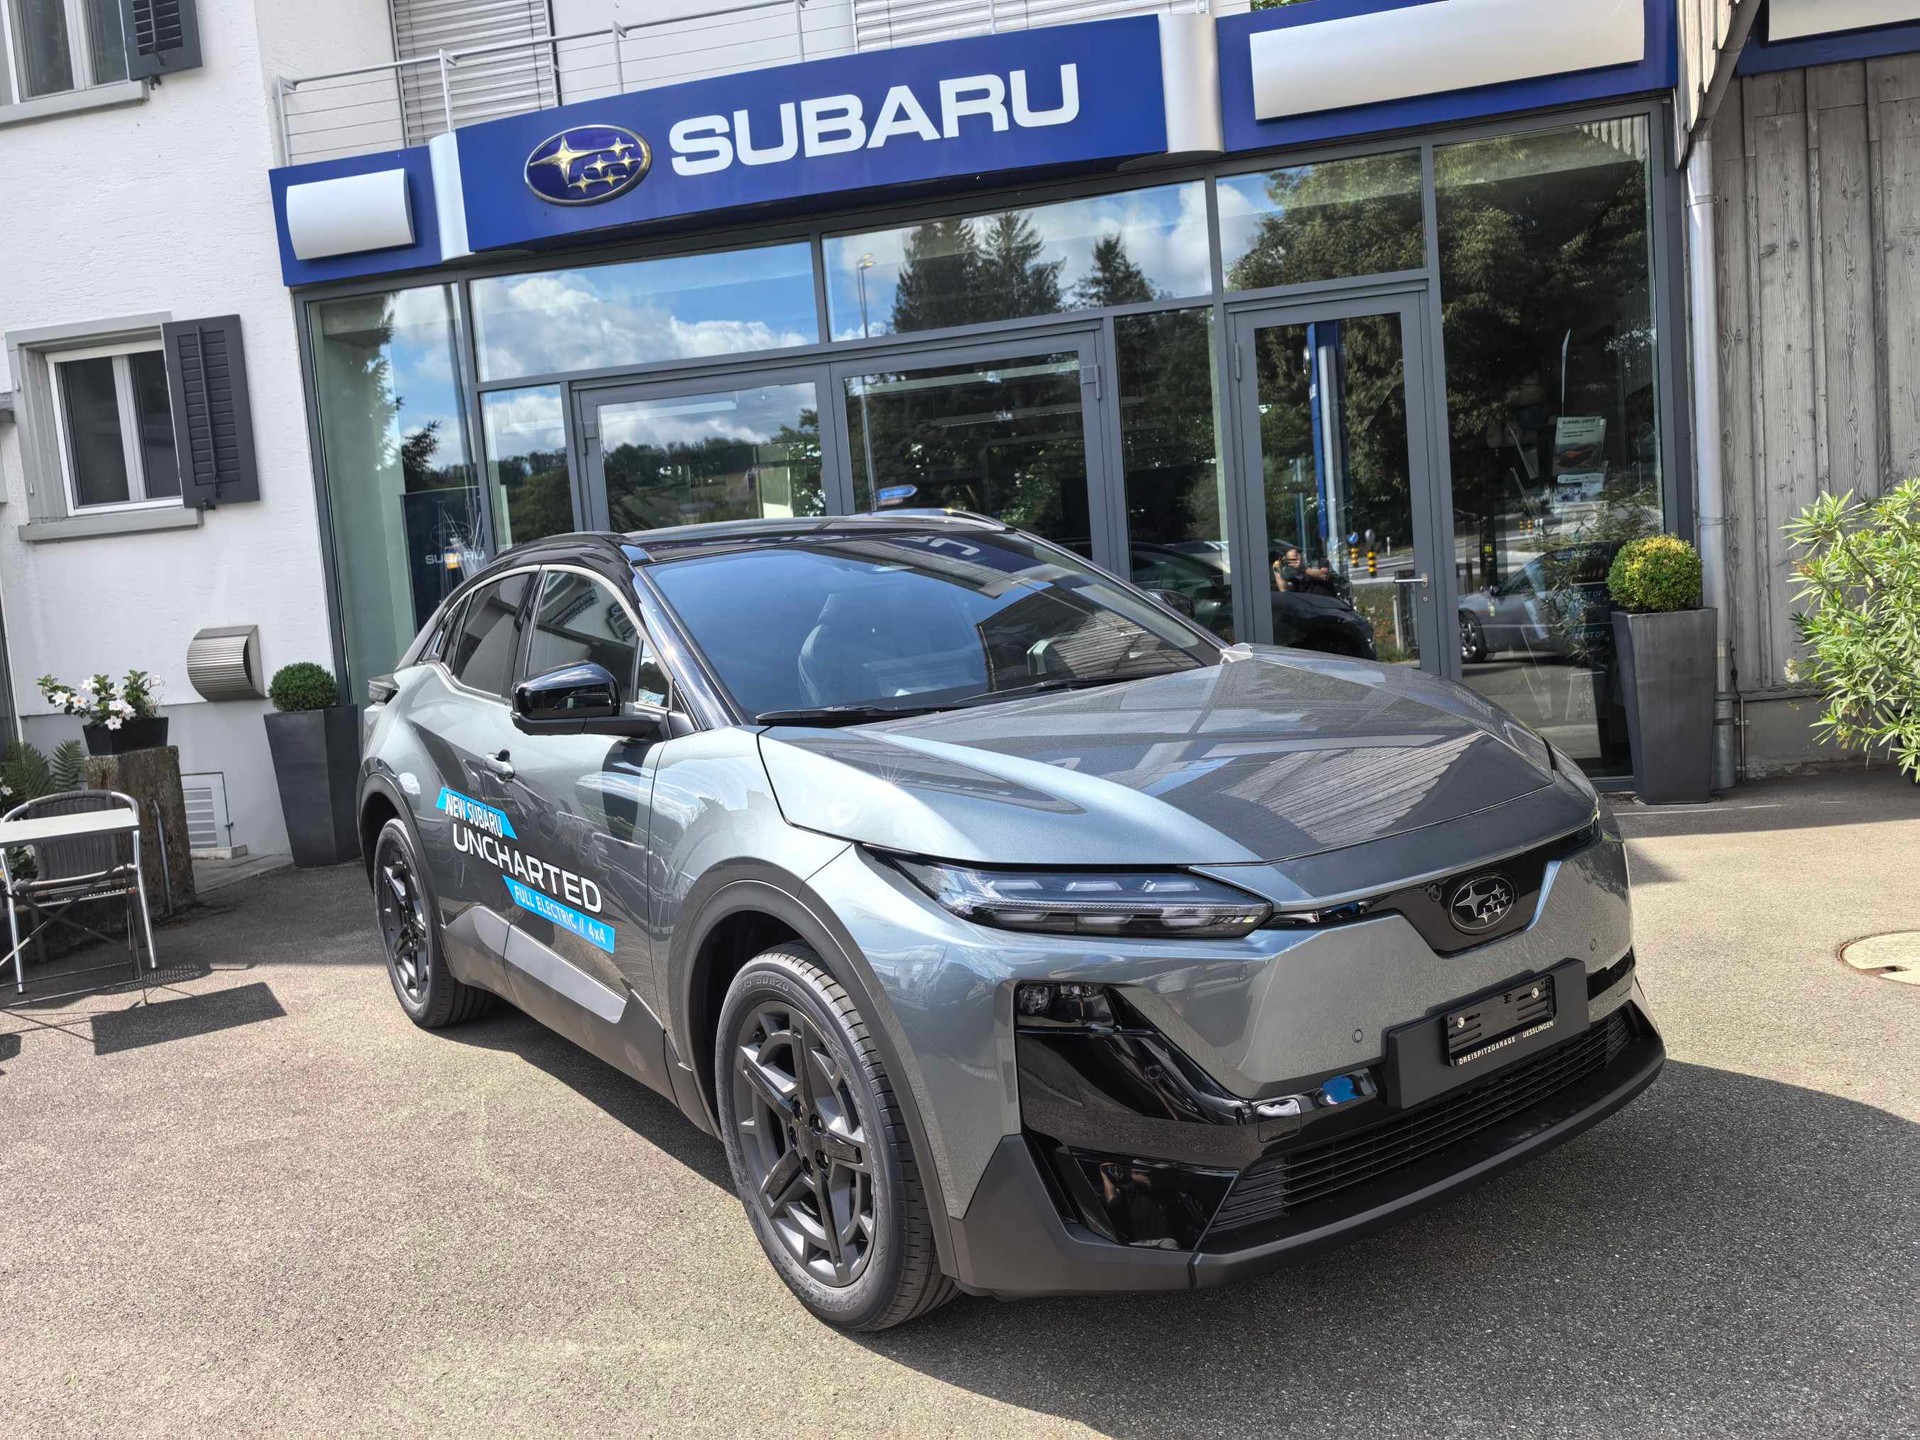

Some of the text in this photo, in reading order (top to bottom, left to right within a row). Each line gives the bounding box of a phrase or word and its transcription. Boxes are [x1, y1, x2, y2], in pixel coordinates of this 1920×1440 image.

[669, 63, 1079, 176] SUBARU
[446, 793, 503, 838] NEW SUBARU
[453, 823, 602, 913] UNCHARTED
[514, 885, 535, 908] FULL
[535, 895, 577, 929] ELECTRIC
[588, 922, 606, 944] 4x4
[1458, 1020, 1554, 1065] DREISPITZGARAGE UESSLINGEN
